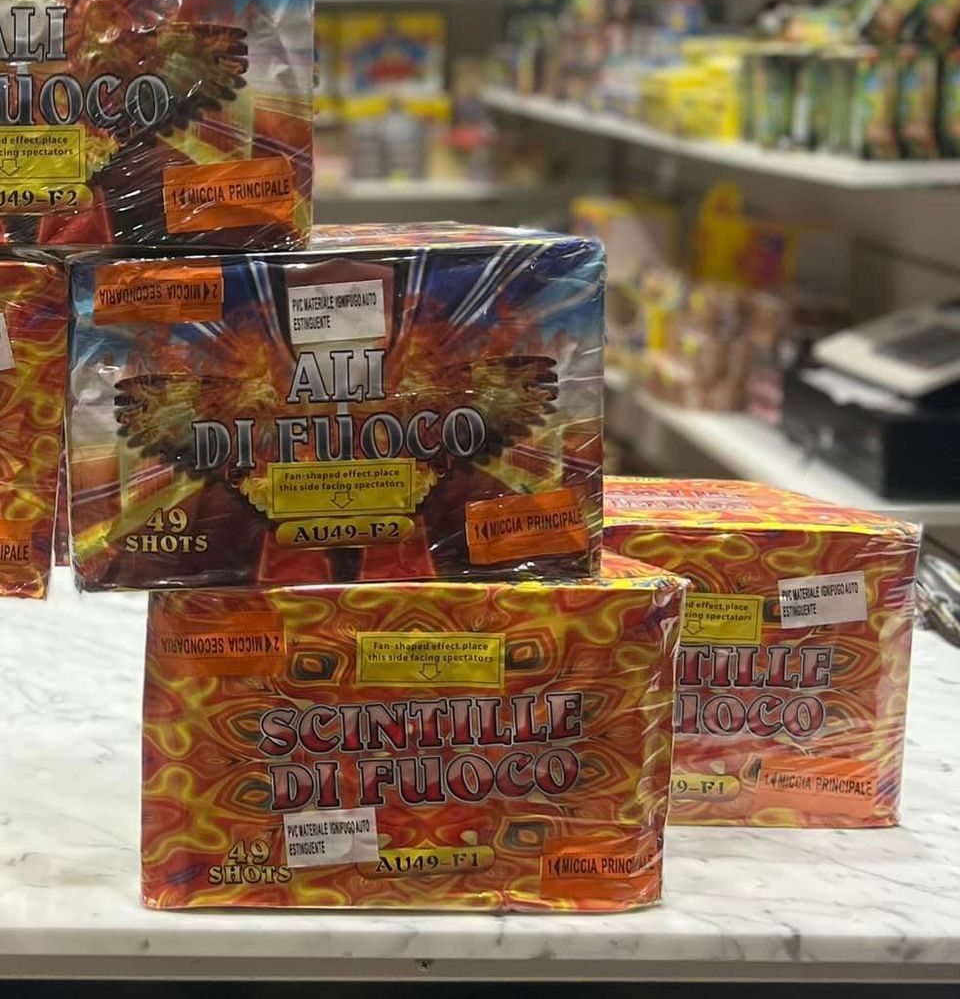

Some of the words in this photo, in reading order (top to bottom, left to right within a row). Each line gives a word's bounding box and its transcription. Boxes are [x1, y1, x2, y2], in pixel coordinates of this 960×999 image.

[21, 147, 73, 157] spectators
[189, 186, 225, 204] MICCIA
[229, 179, 290, 200] PRINCIPALE
[99, 285, 162, 305] SECONDARIA
[167, 284, 202, 300] MICCIA
[291, 298, 303, 311] PVC
[303, 295, 334, 310] MATERIALE
[292, 315, 330, 331] ESTINGUENTE
[286, 348, 386, 404] ALI
[191, 417, 256, 471] DI
[275, 405, 487, 462] FUOCO
[279, 483, 297, 492] this
[299, 482, 319, 491] side
[321, 481, 351, 492] facing
[354, 479, 405, 491] spectators
[284, 471, 340, 482] Fan-shaped
[145, 507, 188, 534] 49
[490, 518, 523, 537] MICCIA
[527, 508, 583, 532] PRINCIPALE
[293, 522, 400, 543] AU49-F2
[126, 534, 208, 553] SHOTS
[706, 612, 752, 622] spectators
[160, 636, 224, 654] SECONDARIA
[228, 636, 263, 650] MICCIA
[373, 642, 429, 654] Fan-shaped
[368, 653, 387, 662] this
[389, 653, 408, 662] side
[410, 653, 440, 664] facing
[442, 654, 494, 664] spectators
[257, 691, 584, 756] SCINTILLE
[268, 760, 342, 812] DI
[357, 747, 581, 807] FUOCO
[816, 778, 872, 796] PRINCIPALE
[287, 824, 298, 838] PVC
[299, 822, 328, 837] MATERIALE
[356, 819, 370, 833] AUTO
[228, 839, 271, 865] 49
[289, 841, 325, 856] ESTINGUENTE
[375, 852, 478, 873] AU49-F1
[562, 858, 598, 874] MICCIA
[208, 864, 292, 884] SHOTS
